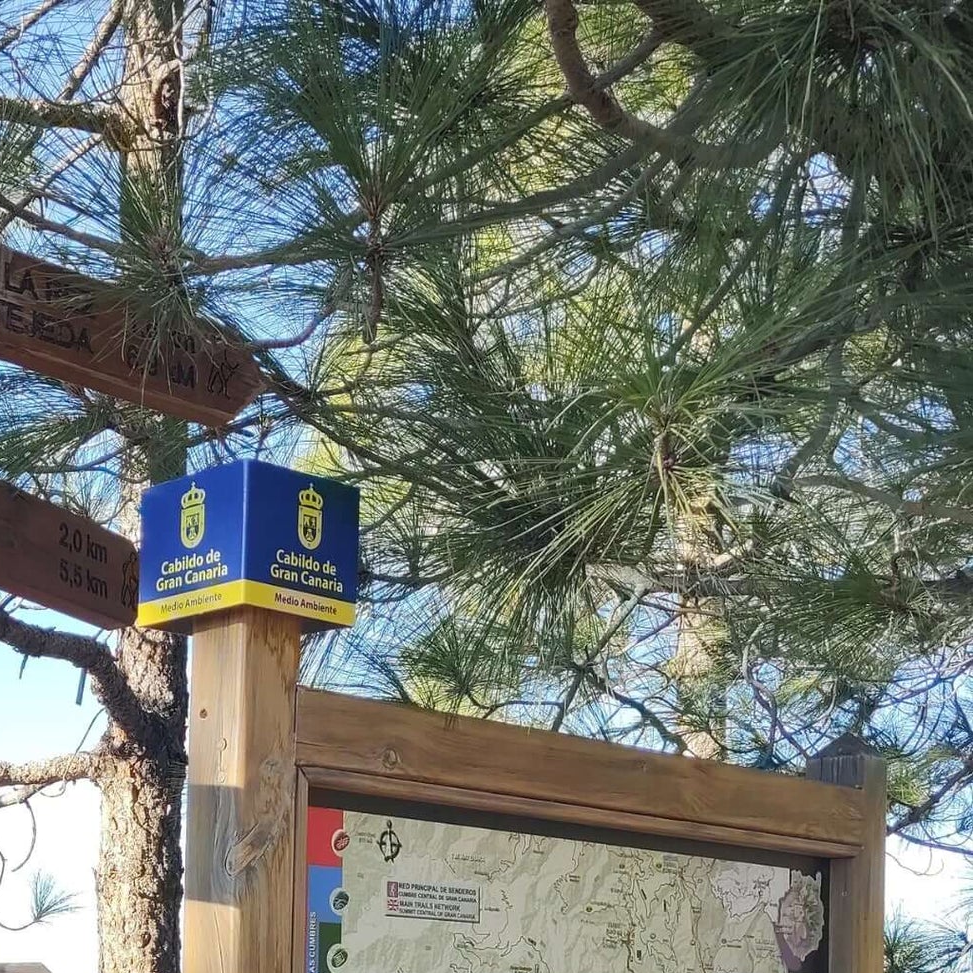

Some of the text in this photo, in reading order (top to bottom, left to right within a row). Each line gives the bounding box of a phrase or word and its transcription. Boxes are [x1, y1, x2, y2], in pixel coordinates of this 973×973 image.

[4, 259, 39, 300] LA
[58, 522, 84, 555] 2,0
[85, 533, 109, 565] km
[161, 548, 222, 576] Cabildo de
[276, 548, 337, 576] Cabildo de
[58, 558, 84, 590] 5,5
[85, 568, 109, 600] km
[155, 562, 229, 593] Gran Canaria
[270, 563, 344, 594] Gran Canaria
[160, 591, 223, 615] Medio Ambiente
[274, 592, 338, 616] Medio Ambiente
[411, 883, 439, 893] PRINCIPAL
